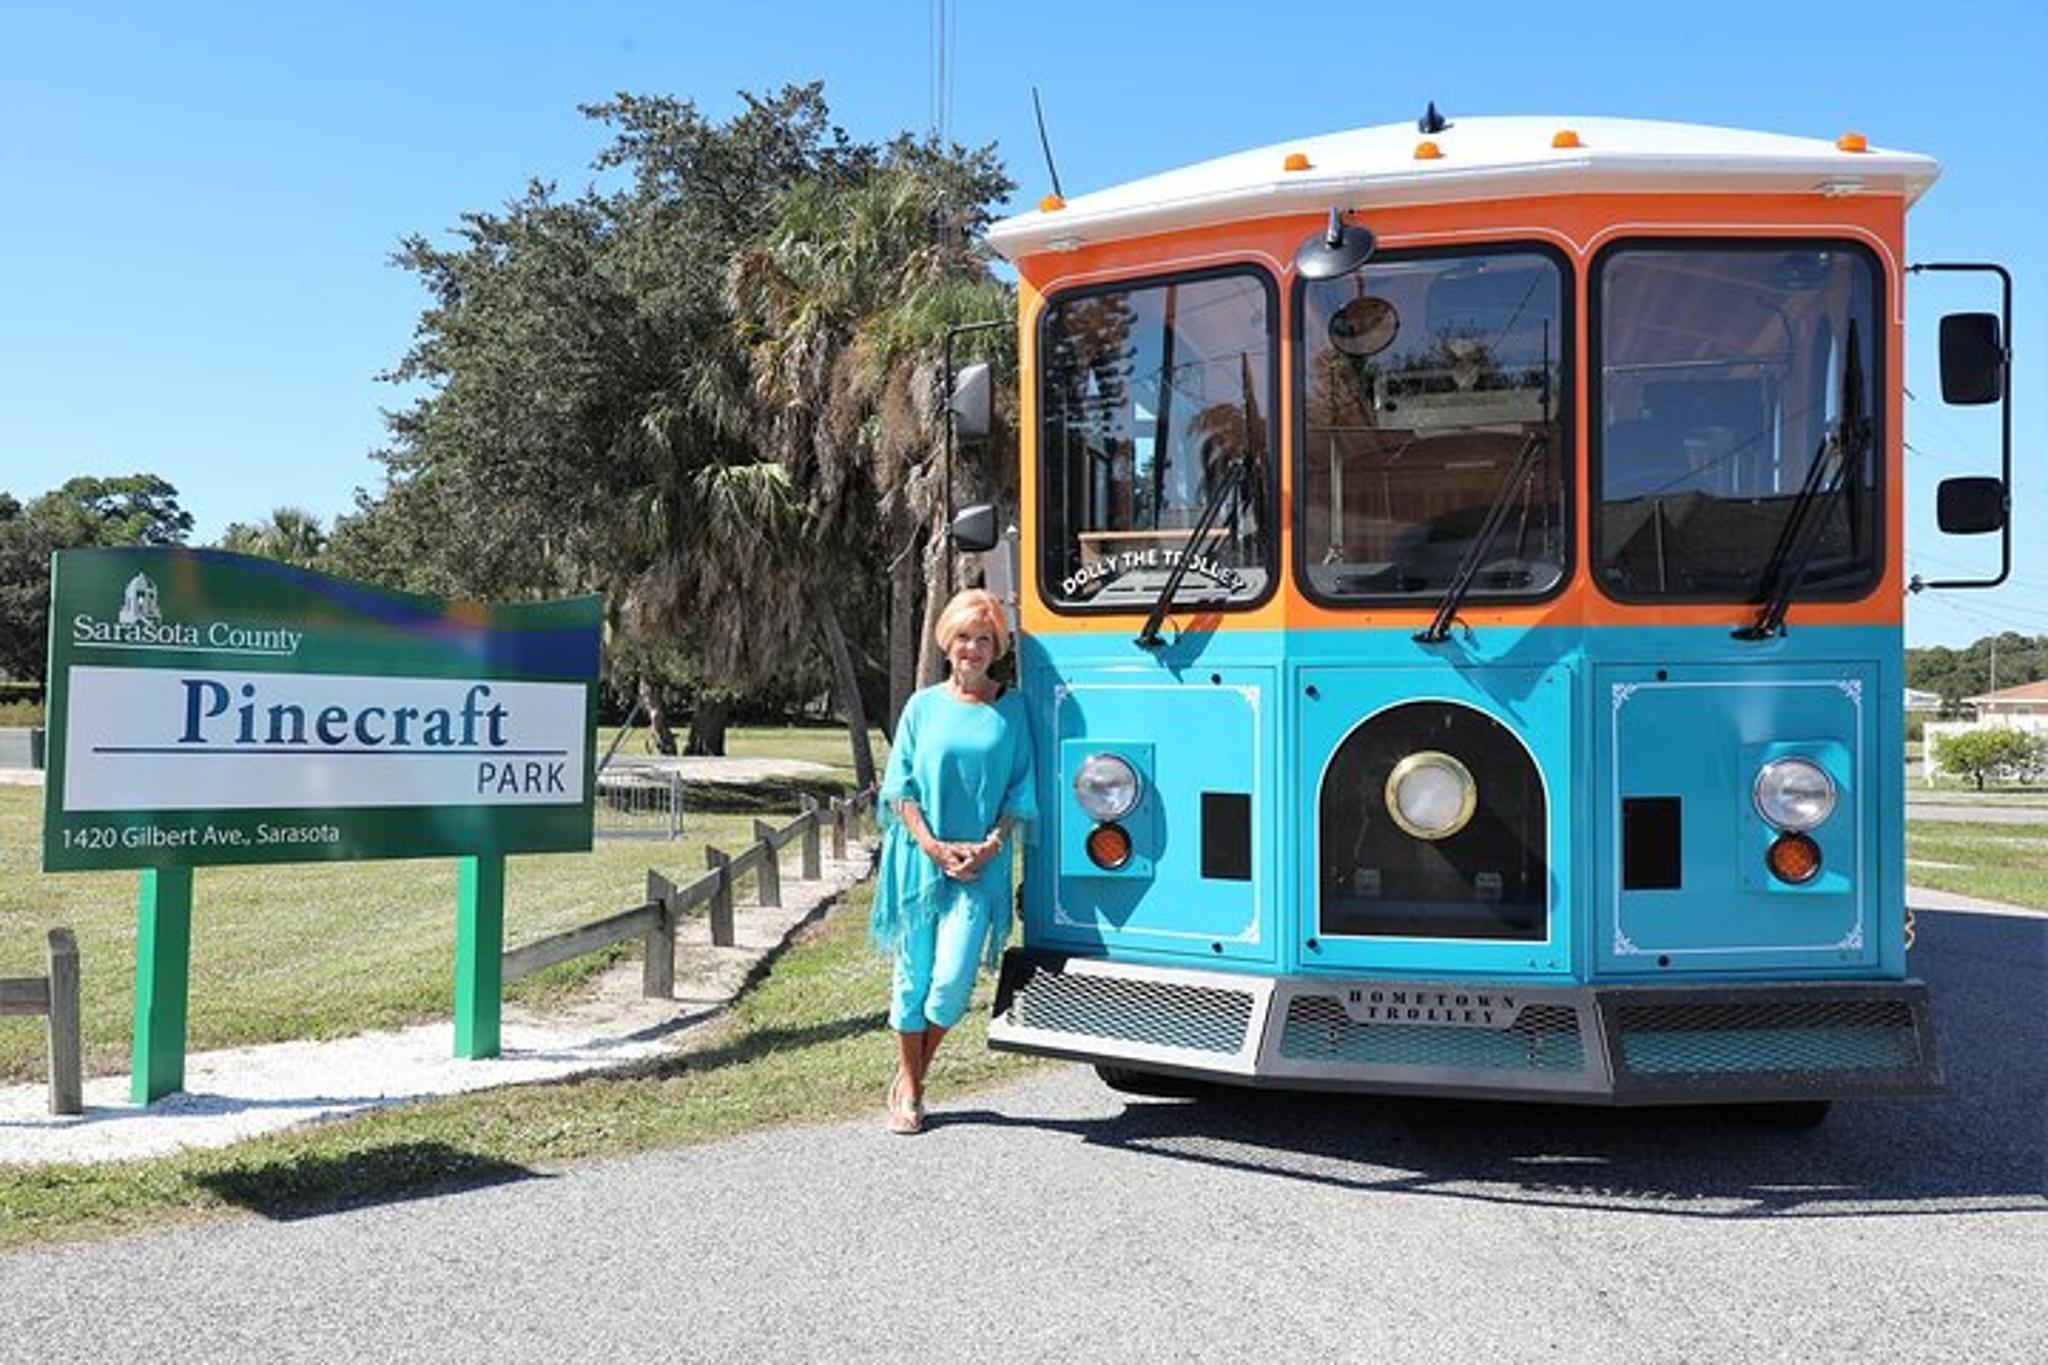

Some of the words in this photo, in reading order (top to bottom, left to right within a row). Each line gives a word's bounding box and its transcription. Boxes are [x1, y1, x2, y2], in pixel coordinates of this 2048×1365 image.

[1062, 556, 1119, 595] DOLLY
[1122, 549, 1158, 567] THE
[73, 613, 199, 645] Sarasota
[208, 621, 302, 652] County
[178, 679, 509, 747] Pinecraft
[477, 762, 566, 794] PARK
[63, 827, 118, 849] 1420
[122, 825, 197, 848] Gilbert
[256, 823, 340, 844] Sarasota
[1349, 990, 1515, 1008] HOMETOWN
[1368, 1006, 1494, 1023] TROLLEY
